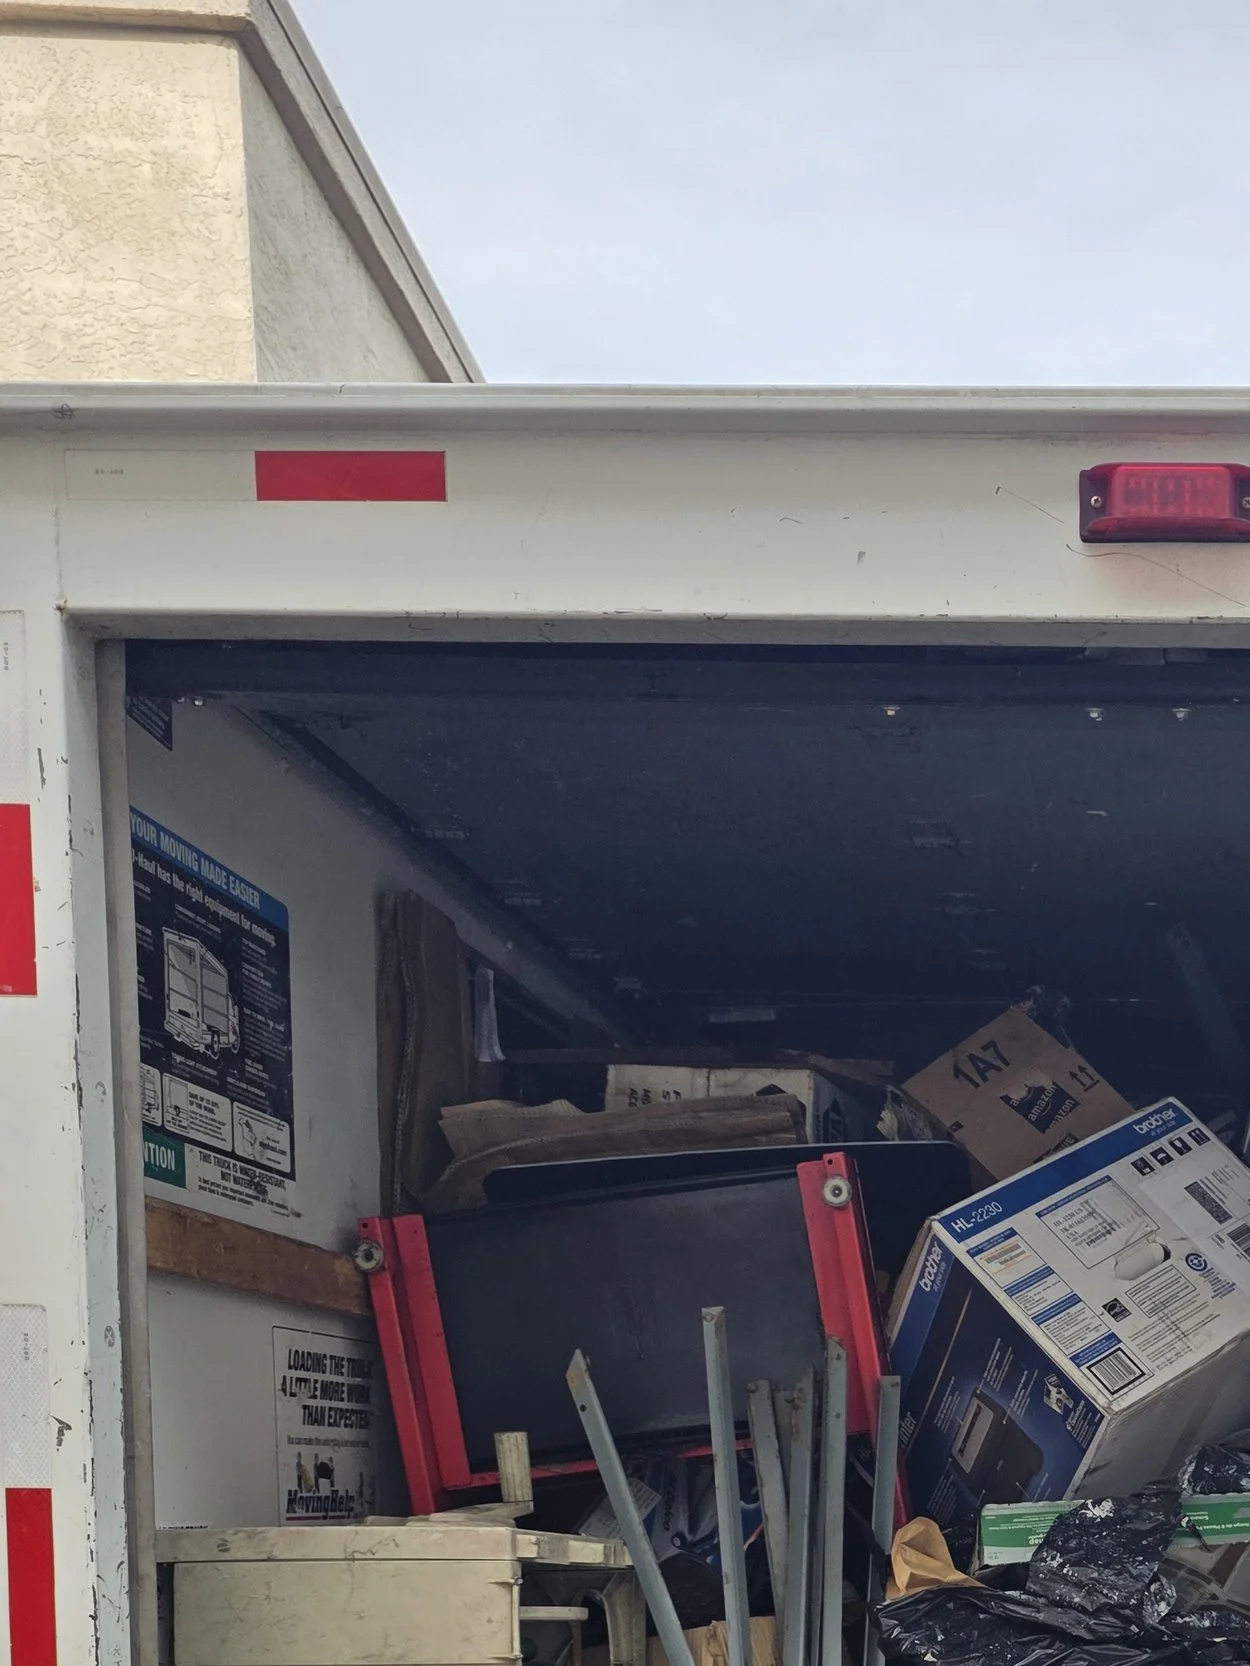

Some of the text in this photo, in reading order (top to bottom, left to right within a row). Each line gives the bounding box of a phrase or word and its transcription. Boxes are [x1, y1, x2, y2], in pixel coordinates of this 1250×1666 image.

[130, 812, 260, 911] YOUR MOVING MADE EASIER
[157, 863, 171, 885] has
[172, 872, 185, 893] the
[186, 881, 203, 904] right
[204, 895, 240, 926] equipment
[952, 1039, 1012, 1090] 1A7
[1027, 1083, 1058, 1123] amazon
[1132, 1107, 1178, 1136] brother
[199, 1150, 213, 1166] THIS
[213, 1154, 231, 1173] TRUCK
[232, 1161, 239, 1174] IS
[221, 1169, 232, 1182] NOT
[951, 1201, 1004, 1234] HL-2230
[919, 1241, 945, 1293] brother
[287, 1348, 346, 1377] LOADING THE
[281, 1375, 288, 1397] A
[320, 1380, 345, 1402] MORE
[347, 1382, 371, 1405] WORK
[302, 1404, 326, 1427] THAN
